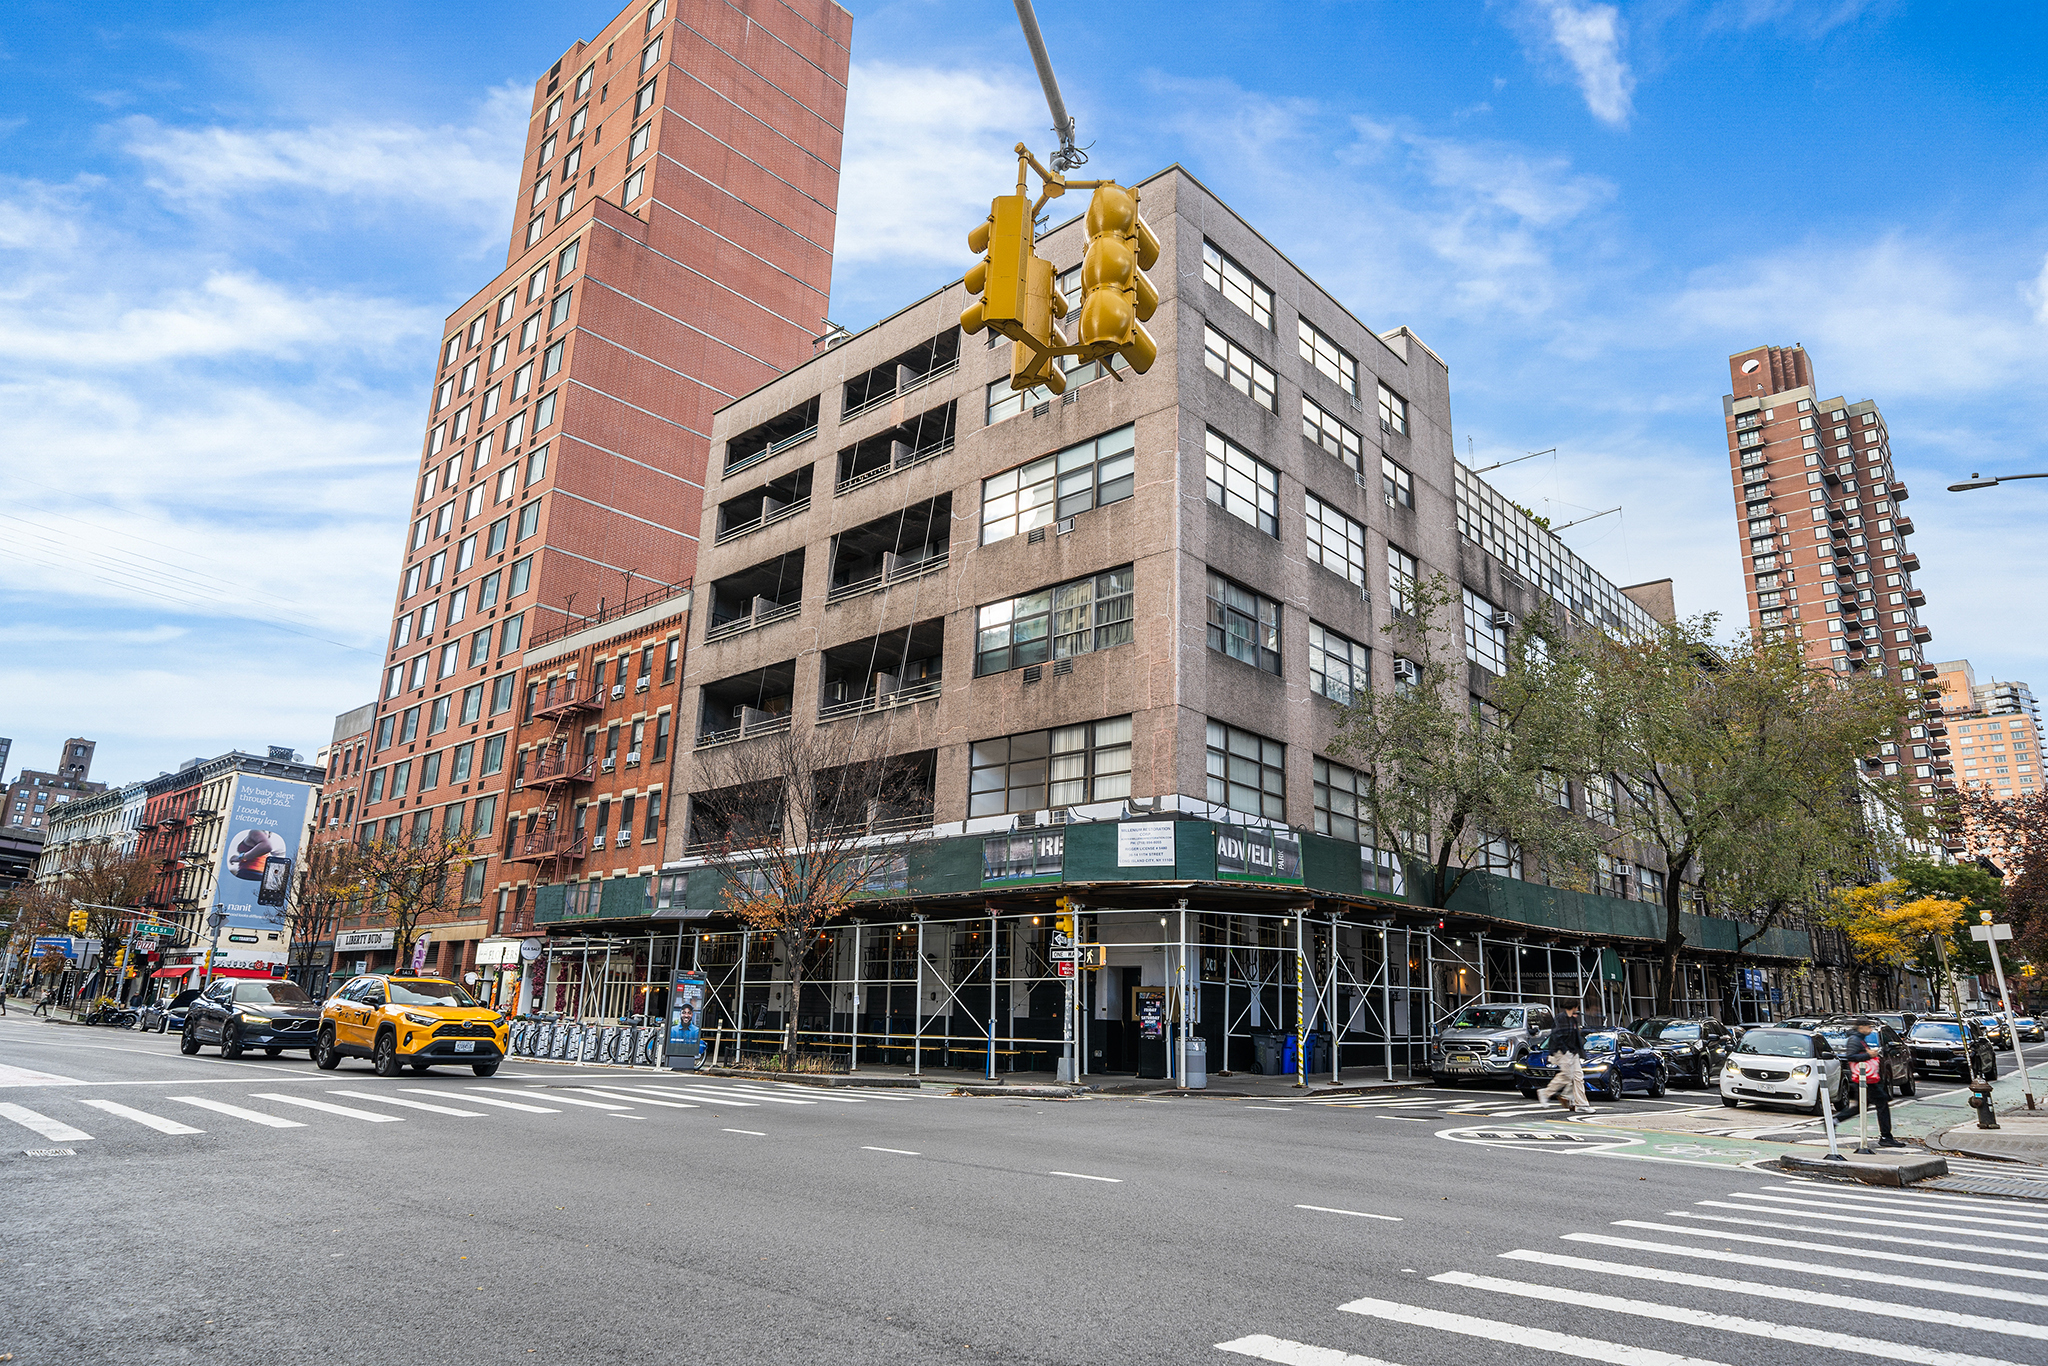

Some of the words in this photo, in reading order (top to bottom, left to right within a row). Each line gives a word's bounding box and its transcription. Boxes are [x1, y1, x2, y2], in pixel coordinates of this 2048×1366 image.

[241, 785, 255, 793] My
[255, 787, 275, 798] baby
[275, 791, 295, 801] slept
[240, 794, 272, 805] through
[241, 806, 260, 815] took
[235, 814, 264, 825] victory
[264, 817, 278, 827] lap.
[227, 903, 252, 912] nanit
[137, 940, 155, 950] PIZZA
[345, 935, 367, 945] LIBERTY
[367, 934, 382, 944] BUDS
[488, 949, 518, 960] FLOERS
